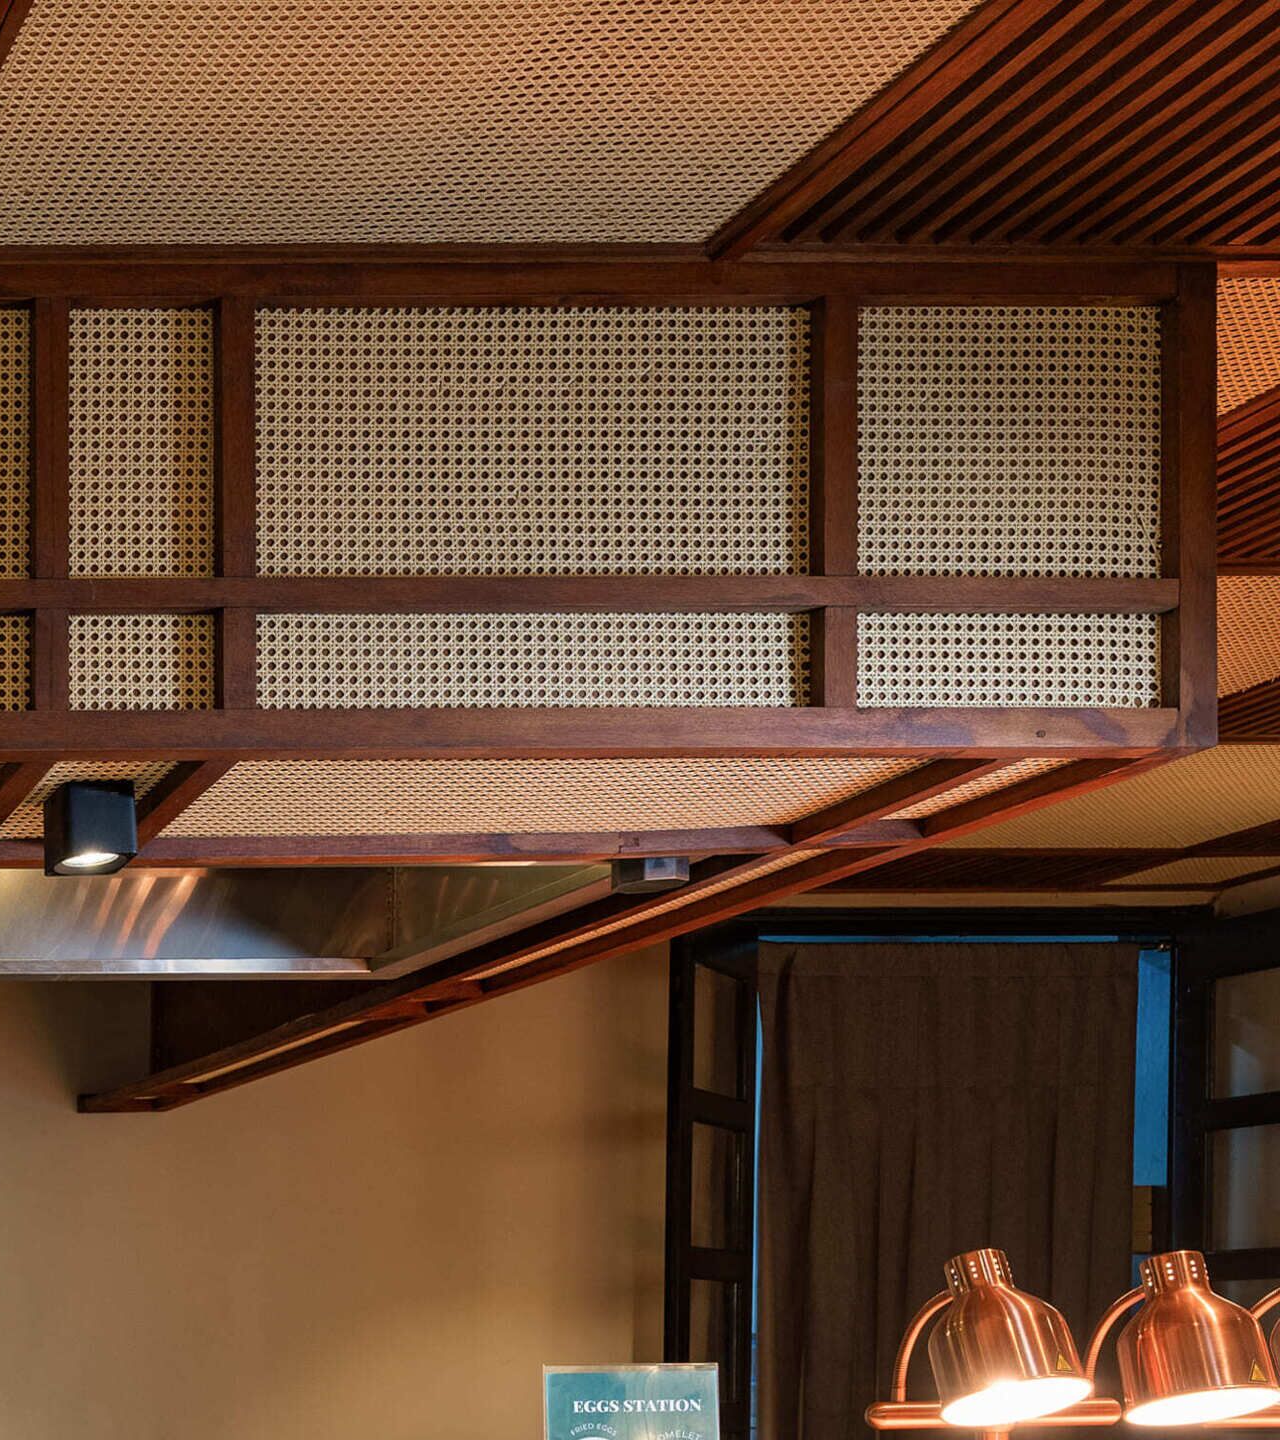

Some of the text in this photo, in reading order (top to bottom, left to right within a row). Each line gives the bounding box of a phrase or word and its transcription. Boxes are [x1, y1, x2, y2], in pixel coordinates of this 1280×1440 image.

[573, 1399, 702, 1413] EGGS STATION
[570, 1423, 618, 1437] FRIED EGGS
